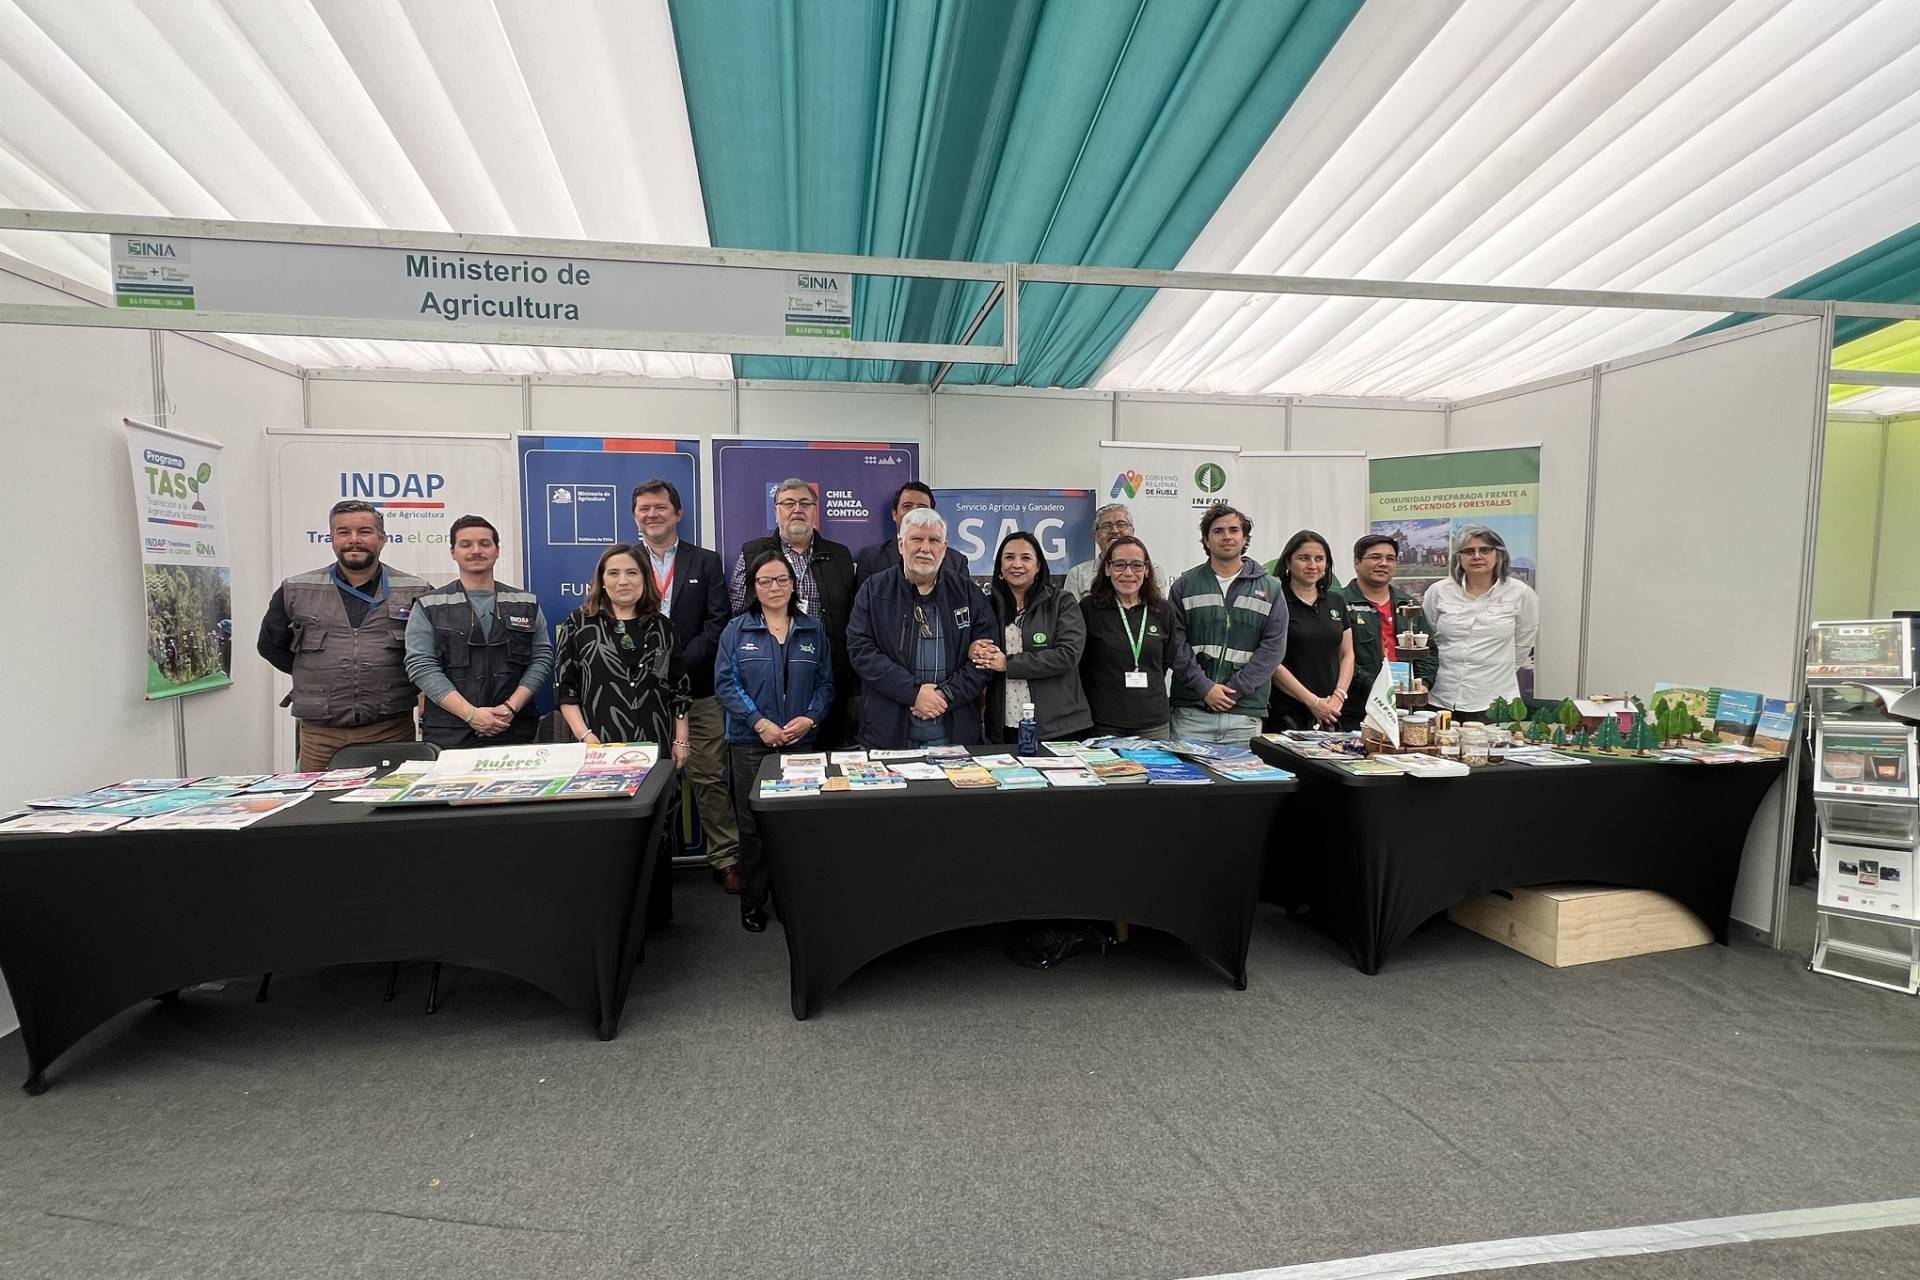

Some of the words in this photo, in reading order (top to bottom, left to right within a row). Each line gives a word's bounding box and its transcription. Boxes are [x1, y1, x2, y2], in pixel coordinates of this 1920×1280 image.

[142, 242, 176, 257] INIA
[406, 254, 548, 284] Ministerio
[557, 262, 591, 286] de
[810, 277, 838, 290] INIA
[420, 291, 579, 321] Agricultura
[146, 450, 183, 467] Programa
[145, 466, 187, 499] TAS
[340, 472, 445, 498] INDAP
[826, 490, 852, 498] CHILE
[1156, 488, 1178, 496] ÑUBLE
[1380, 495, 1431, 505] COMUNIDAD
[1432, 492, 1483, 502] PREPARADA
[1485, 490, 1519, 499] FRENTE
[826, 500, 863, 508] AVANZA
[956, 503, 988, 512] Servicio
[988, 503, 1020, 513] Agrícola
[1022, 504, 1027, 513] y
[1028, 503, 1065, 512] Ganadero
[1410, 502, 1457, 512] INCENDIOS
[1459, 499, 1512, 509] FORESTALES
[399, 511, 445, 519] Agricultura
[826, 509, 869, 517] CONTIGO
[408, 532, 422, 544] el
[474, 754, 541, 768] Mujeres
